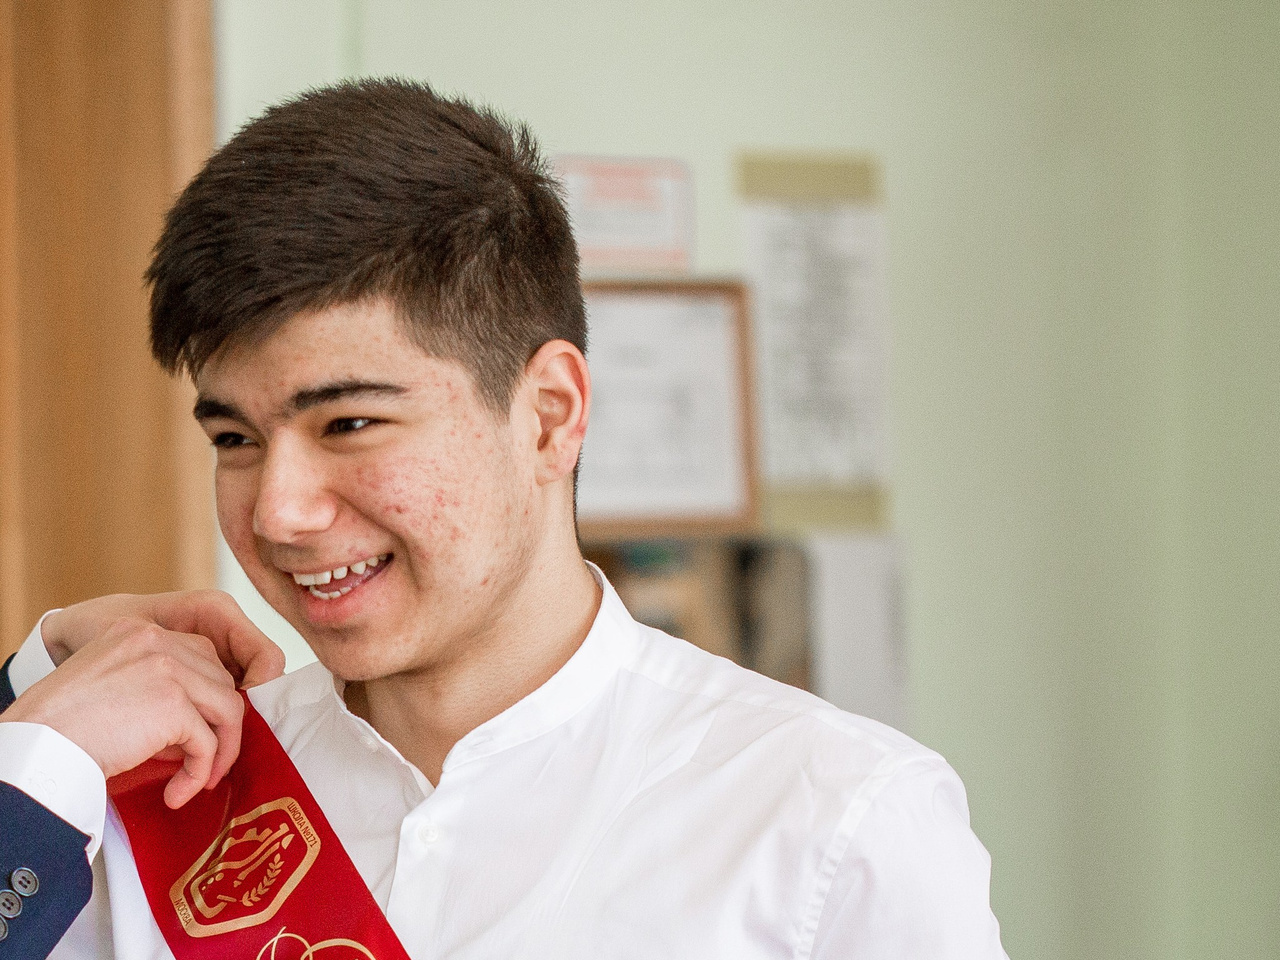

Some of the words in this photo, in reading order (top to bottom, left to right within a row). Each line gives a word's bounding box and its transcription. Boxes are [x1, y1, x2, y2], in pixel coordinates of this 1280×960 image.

[287, 801, 305, 829] ШКОЛА
[301, 825, 318, 848] №171
[174, 898, 193, 926] МОСКВА
